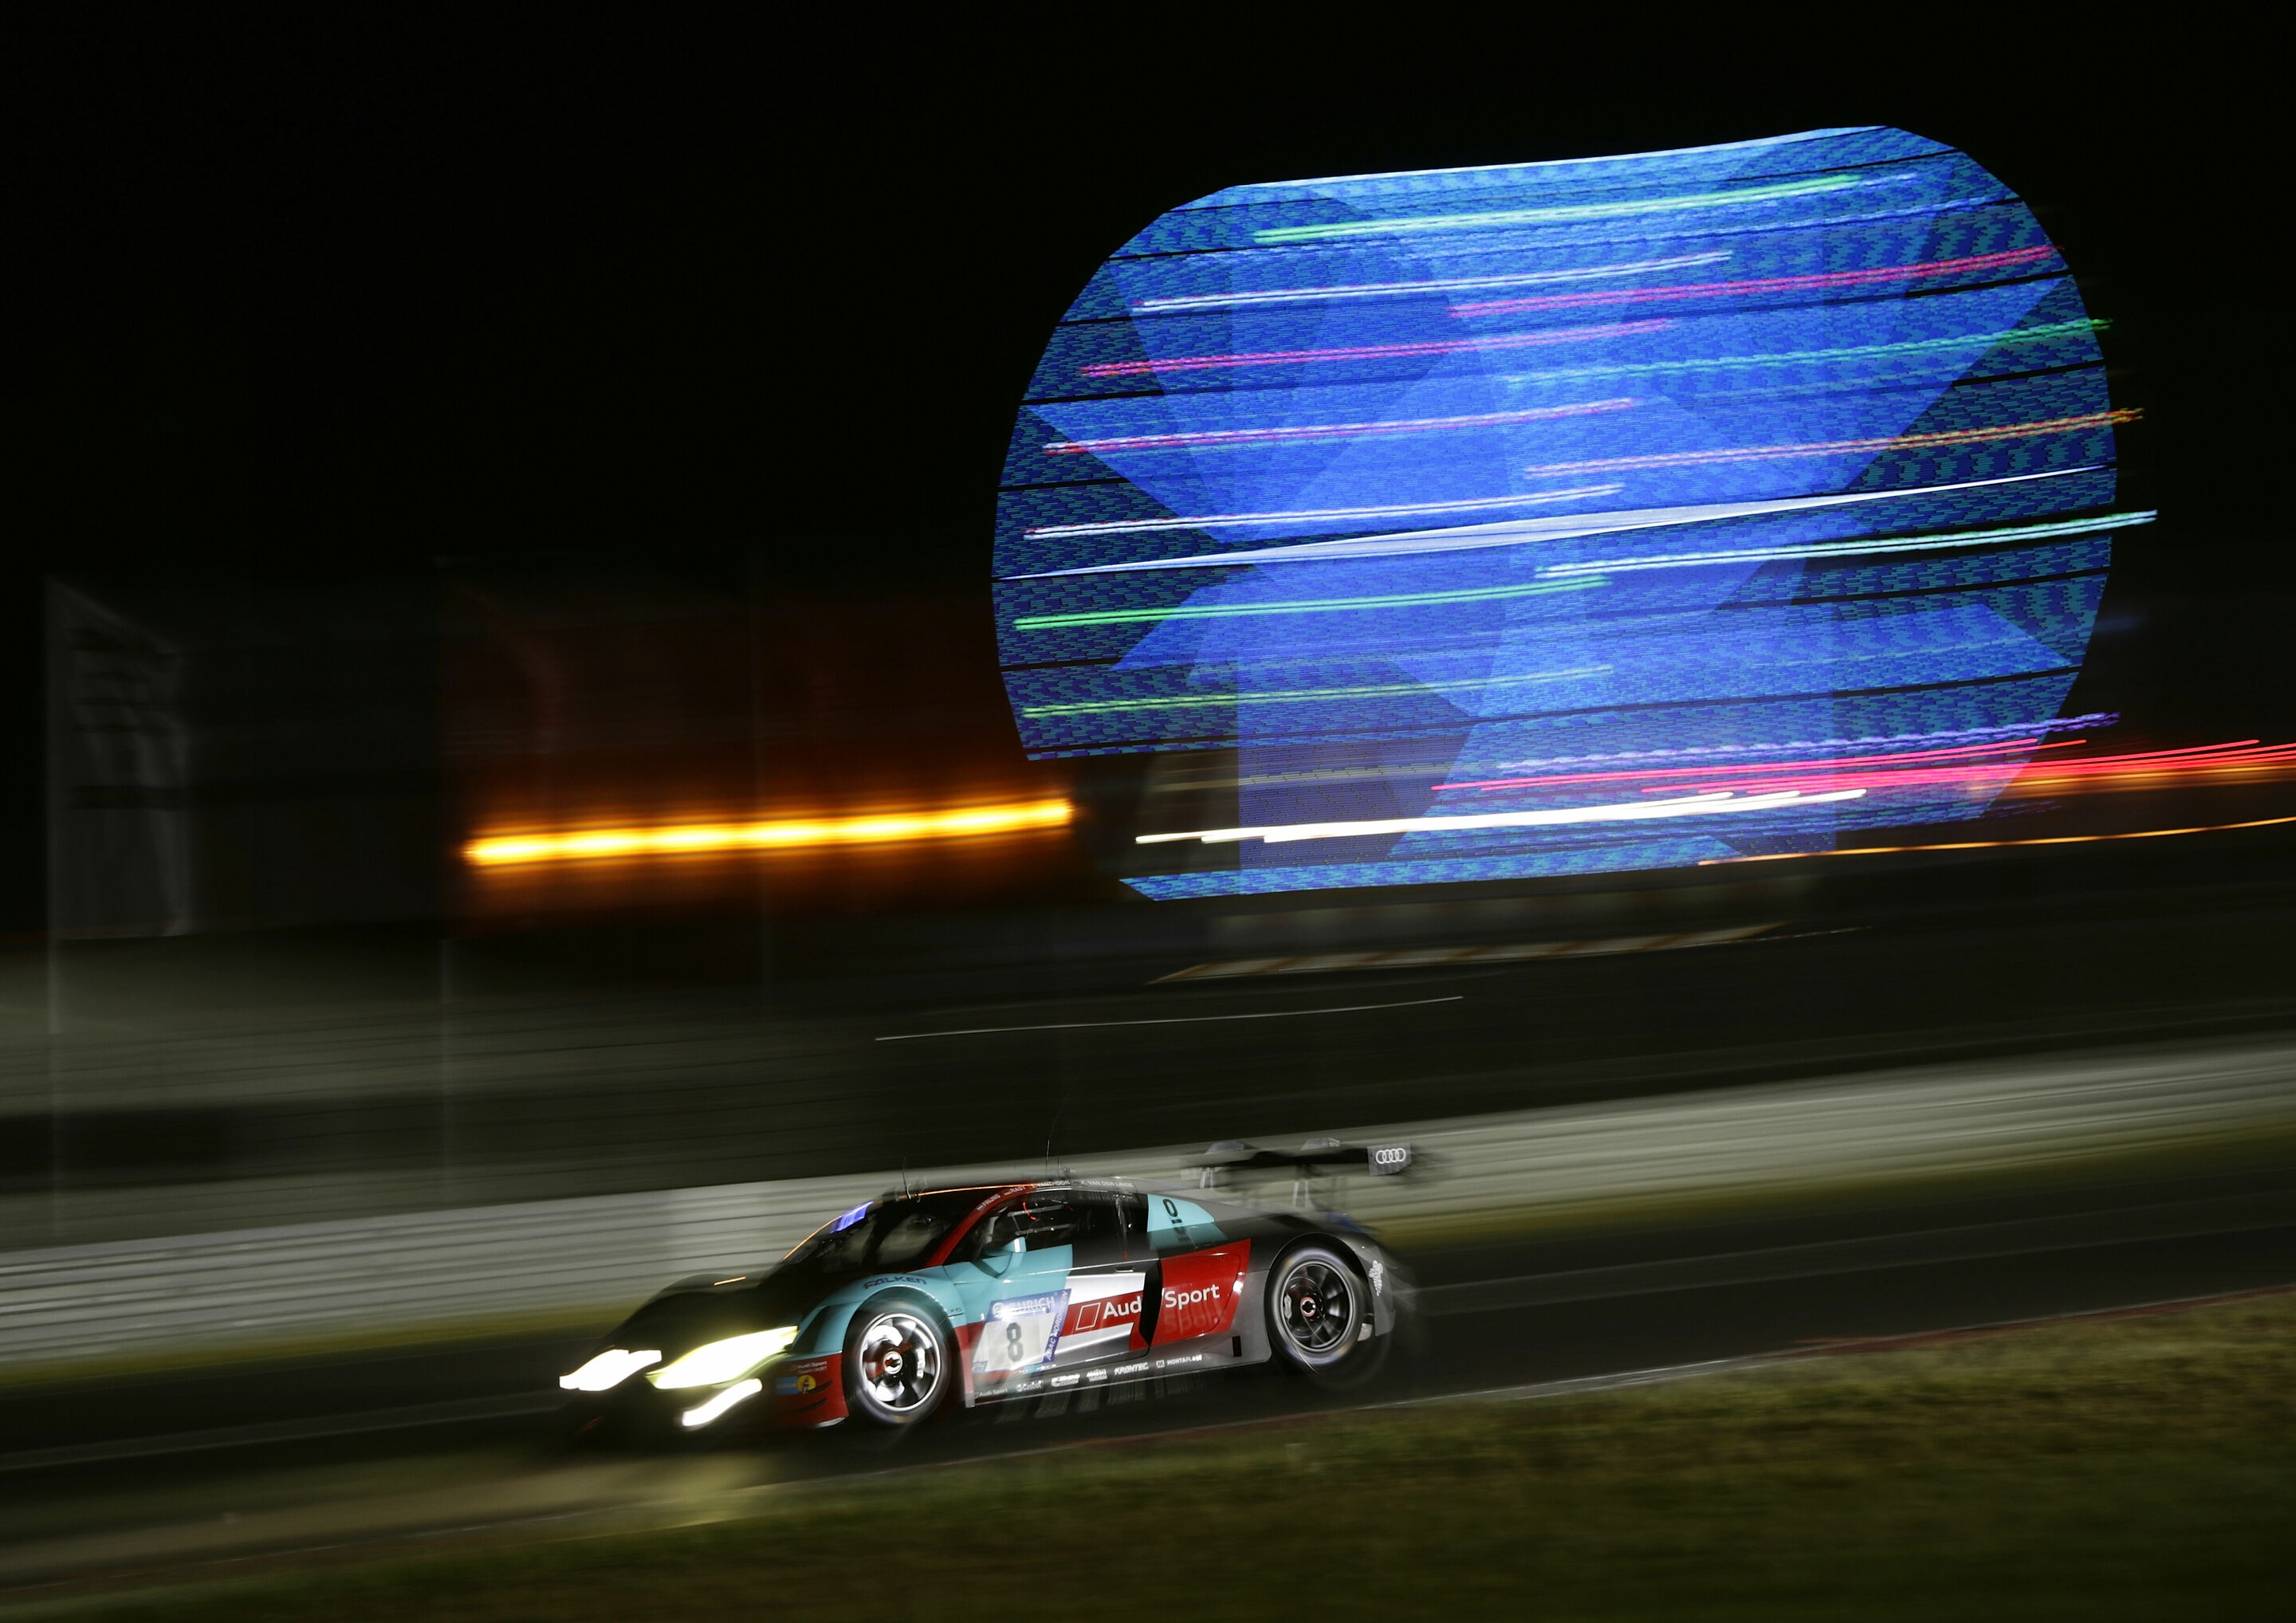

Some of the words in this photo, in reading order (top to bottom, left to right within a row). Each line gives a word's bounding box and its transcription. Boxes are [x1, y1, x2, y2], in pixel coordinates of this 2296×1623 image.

[863, 1276, 926, 1289] FALKEN
[1103, 1295, 1142, 1319] Aud
[1164, 1283, 1221, 1310] Sport
[1006, 1322, 1024, 1362] 8
